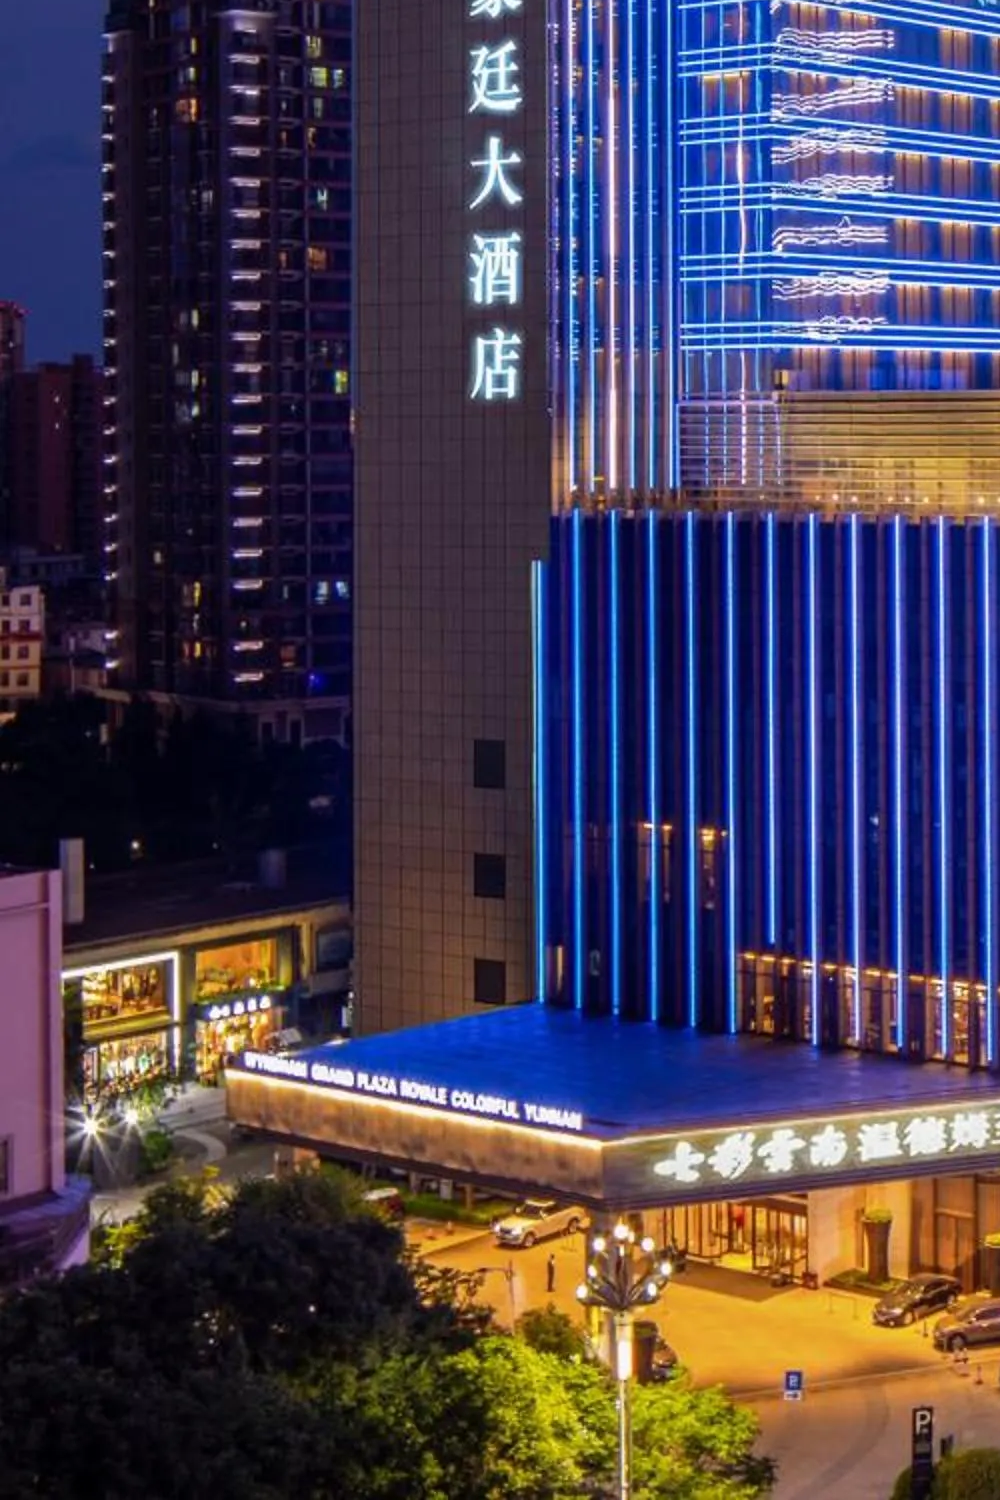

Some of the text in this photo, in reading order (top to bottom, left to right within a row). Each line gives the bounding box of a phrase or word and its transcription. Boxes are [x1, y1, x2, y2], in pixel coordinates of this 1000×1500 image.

[357, 1072, 397, 1096] PLAZA
[400, 1080, 447, 1106] ROYALE
[451, 1090, 520, 1119] COLORFUL
[916, 1411, 931, 1435] P
